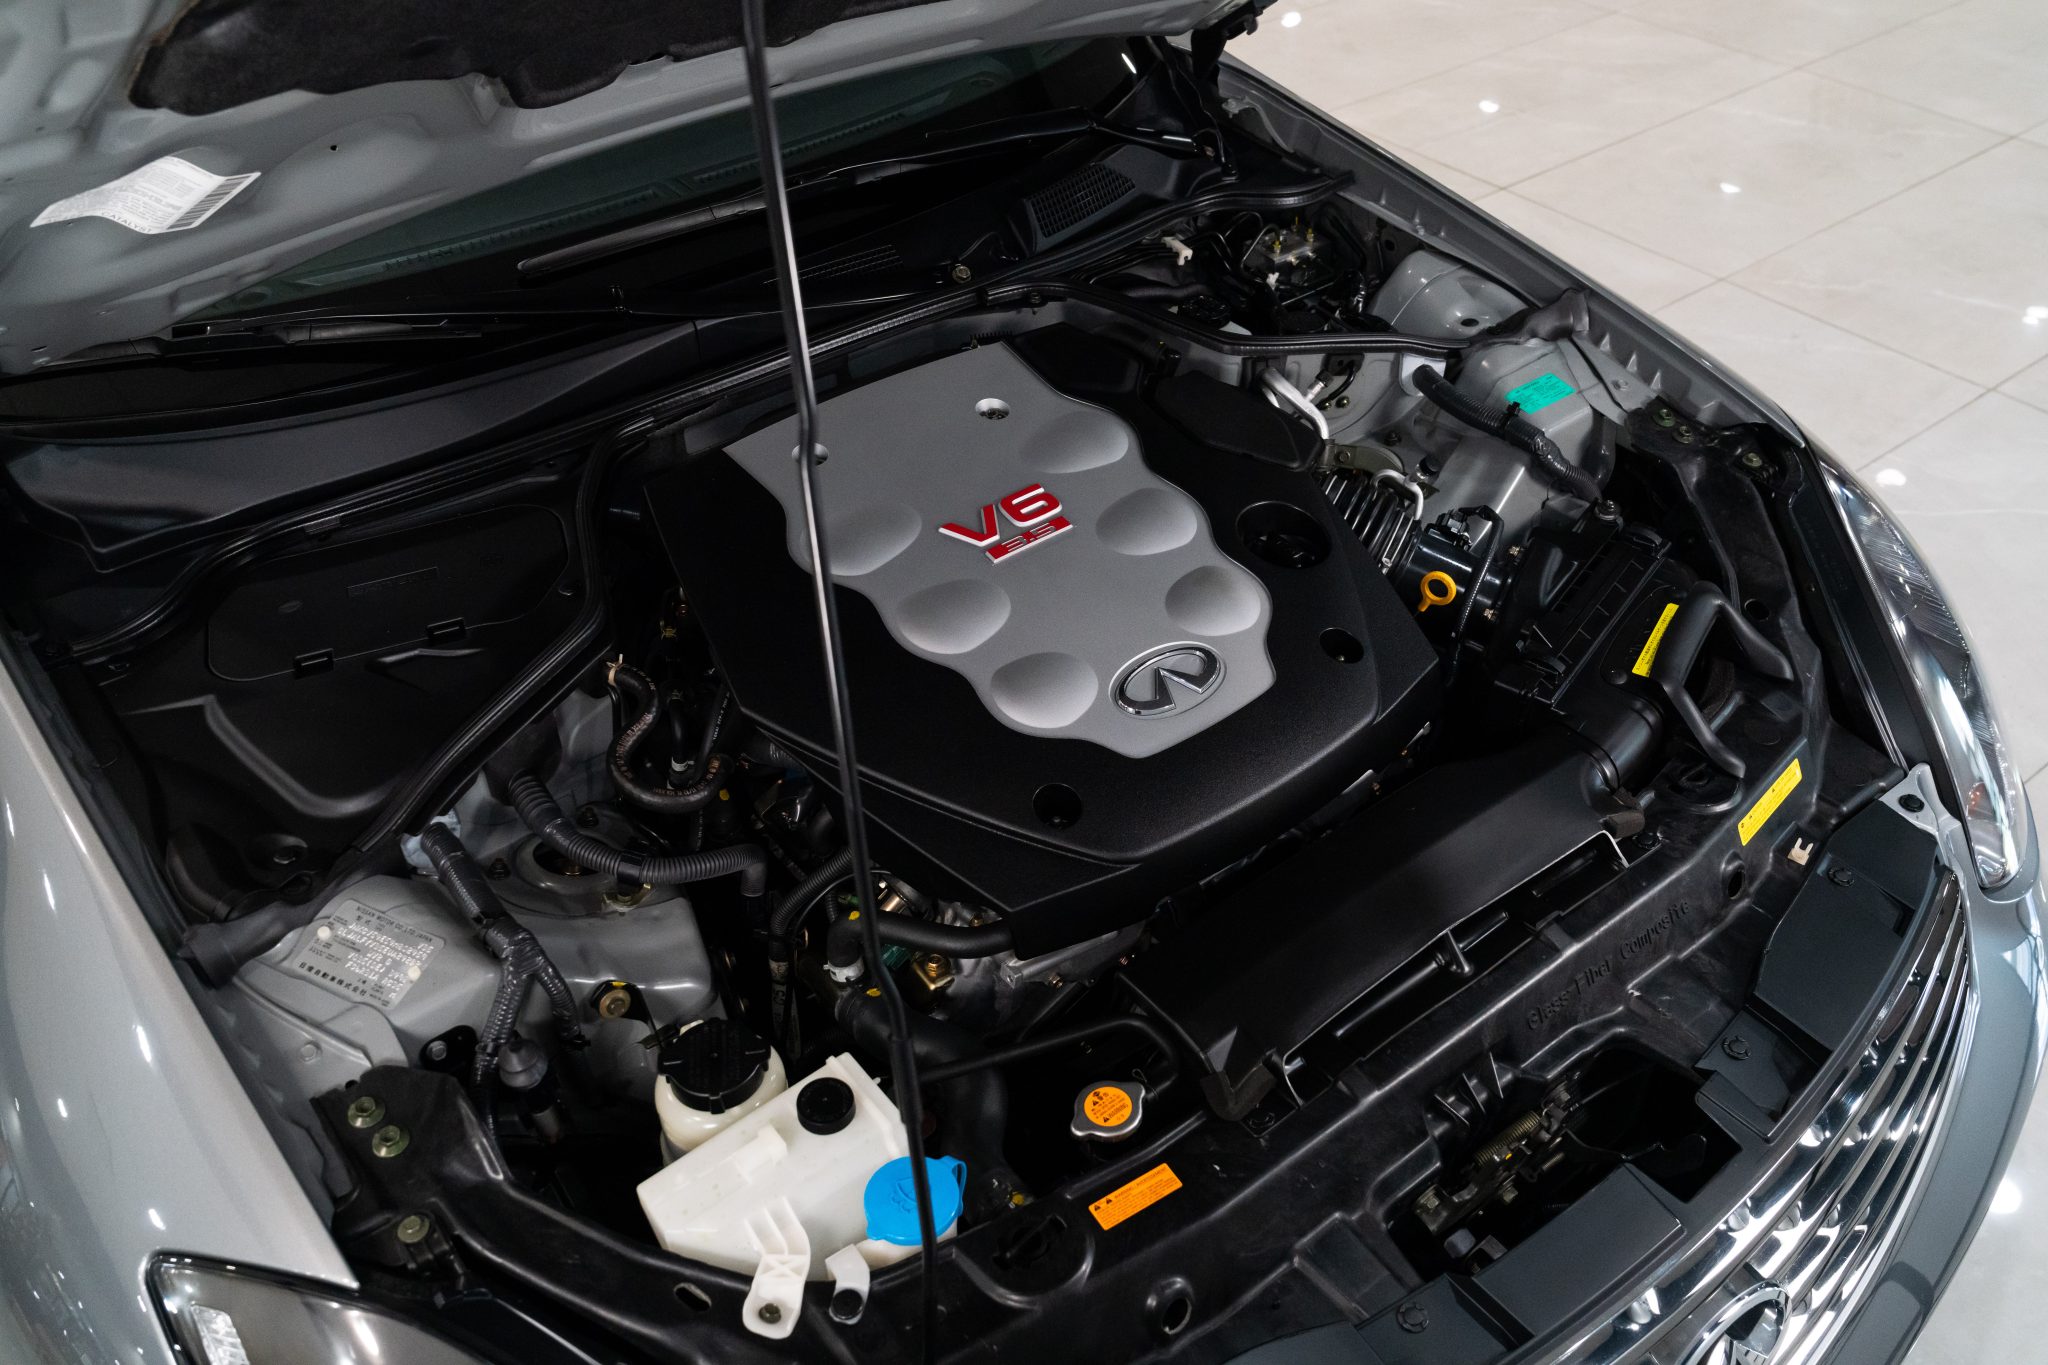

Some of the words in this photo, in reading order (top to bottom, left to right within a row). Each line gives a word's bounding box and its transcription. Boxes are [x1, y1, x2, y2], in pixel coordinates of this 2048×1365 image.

[938, 482, 1063, 547] V6
[998, 520, 1059, 555] 3.5
[1619, 901, 1689, 960] Composite
